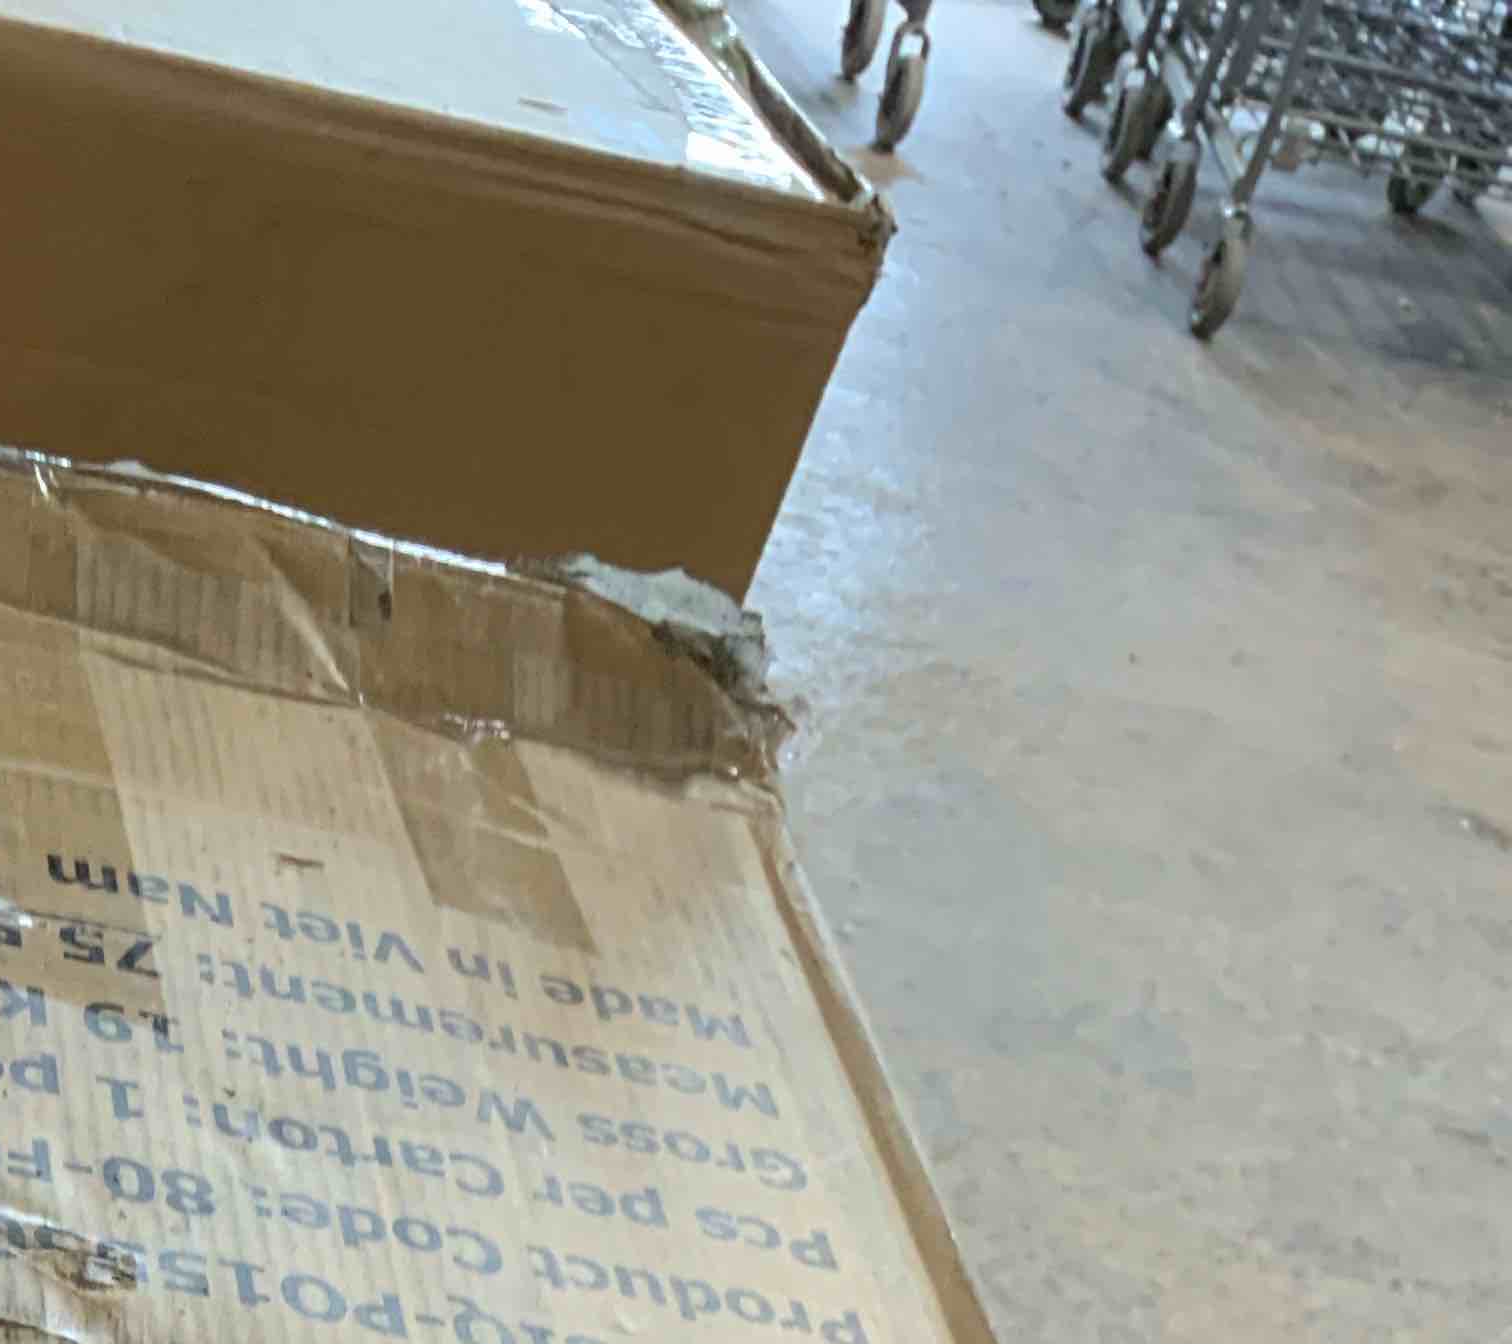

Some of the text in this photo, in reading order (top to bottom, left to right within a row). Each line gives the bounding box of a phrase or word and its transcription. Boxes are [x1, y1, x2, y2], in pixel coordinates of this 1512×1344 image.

[45, 853, 752, 1048] Made in Viet Nam
[84, 1002, 184, 1055] 19
[196, 953, 779, 1120] Measurement:
[95, 1076, 143, 1122] 1
[221, 1029, 556, 1143] Weight:
[182, 1094, 505, 1200] Carton:
[577, 1114, 808, 1192] Gross
[244, 1184, 502, 1275] Code:
[533, 1174, 668, 1229] per
[694, 1207, 839, 1272] Pcs
